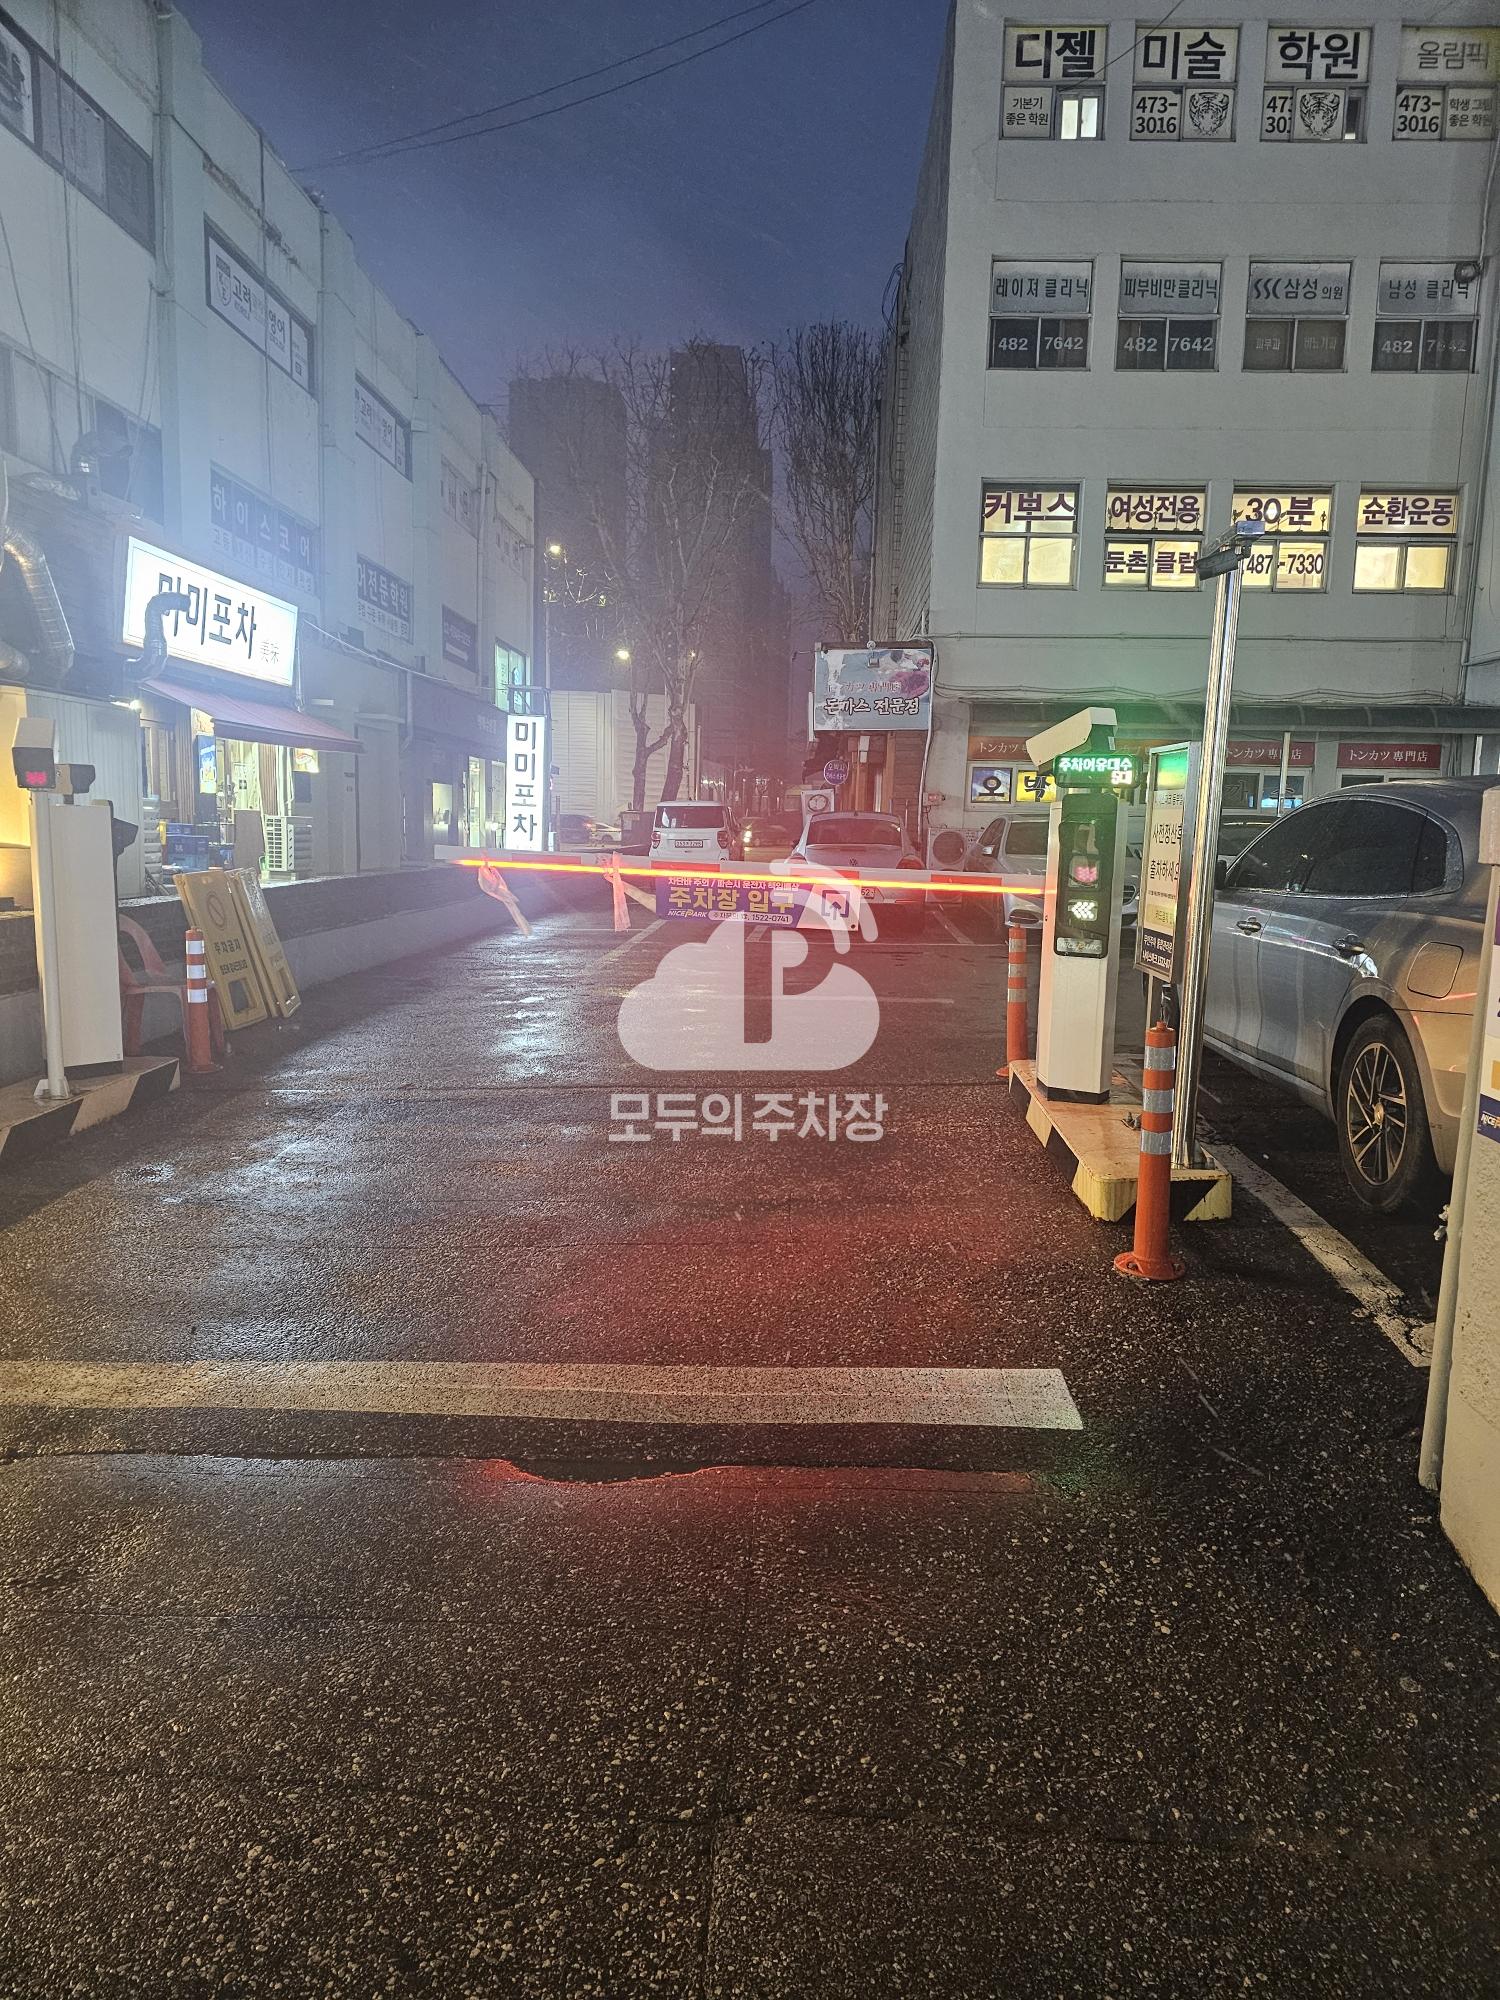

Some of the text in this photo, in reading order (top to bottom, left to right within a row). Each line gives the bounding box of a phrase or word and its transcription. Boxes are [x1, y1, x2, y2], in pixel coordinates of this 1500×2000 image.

[1015, 30, 1361, 80] 디젤 미술 학원
[1417, 41, 1489, 70] 올림픽
[1012, 97, 1043, 110] 기본기
[1135, 96, 1178, 114] 473-
[1399, 95, 1441, 113] 473-
[1450, 98, 1470, 111] 학생
[1006, 113, 1049, 126] 좋은 학원
[1135, 116, 1177, 134] 3016
[1397, 115, 1439, 133] 3016
[1449, 114, 1469, 127] 좋은
[1045, 278, 1088, 298] 클리닉
[1284, 278, 1344, 300] 삼성 의원
[1389, 279, 1469, 300] 남성 클리닉
[998, 336, 1084, 352] 482 7642
[1124, 336, 1214, 353] 482 7642
[1381, 340, 1413, 354] 482
[983, 491, 1454, 527] 커브스 여성전용 30분 순환운동
[213, 484, 311, 566] 하이스코어
[1104, 551, 1198, 574] 둔촌 클럽
[824, 697, 920, 716] 돈까스 전문점
[979, 742, 1019, 753] トンカツ
[1349, 750, 1390, 761] トンカツ
[511, 721, 538, 842] 미미포차
[979, 775, 1005, 798] 오
[669, 886, 795, 914] 주차장 입구
[752, 914, 790, 923] 1522-0741
